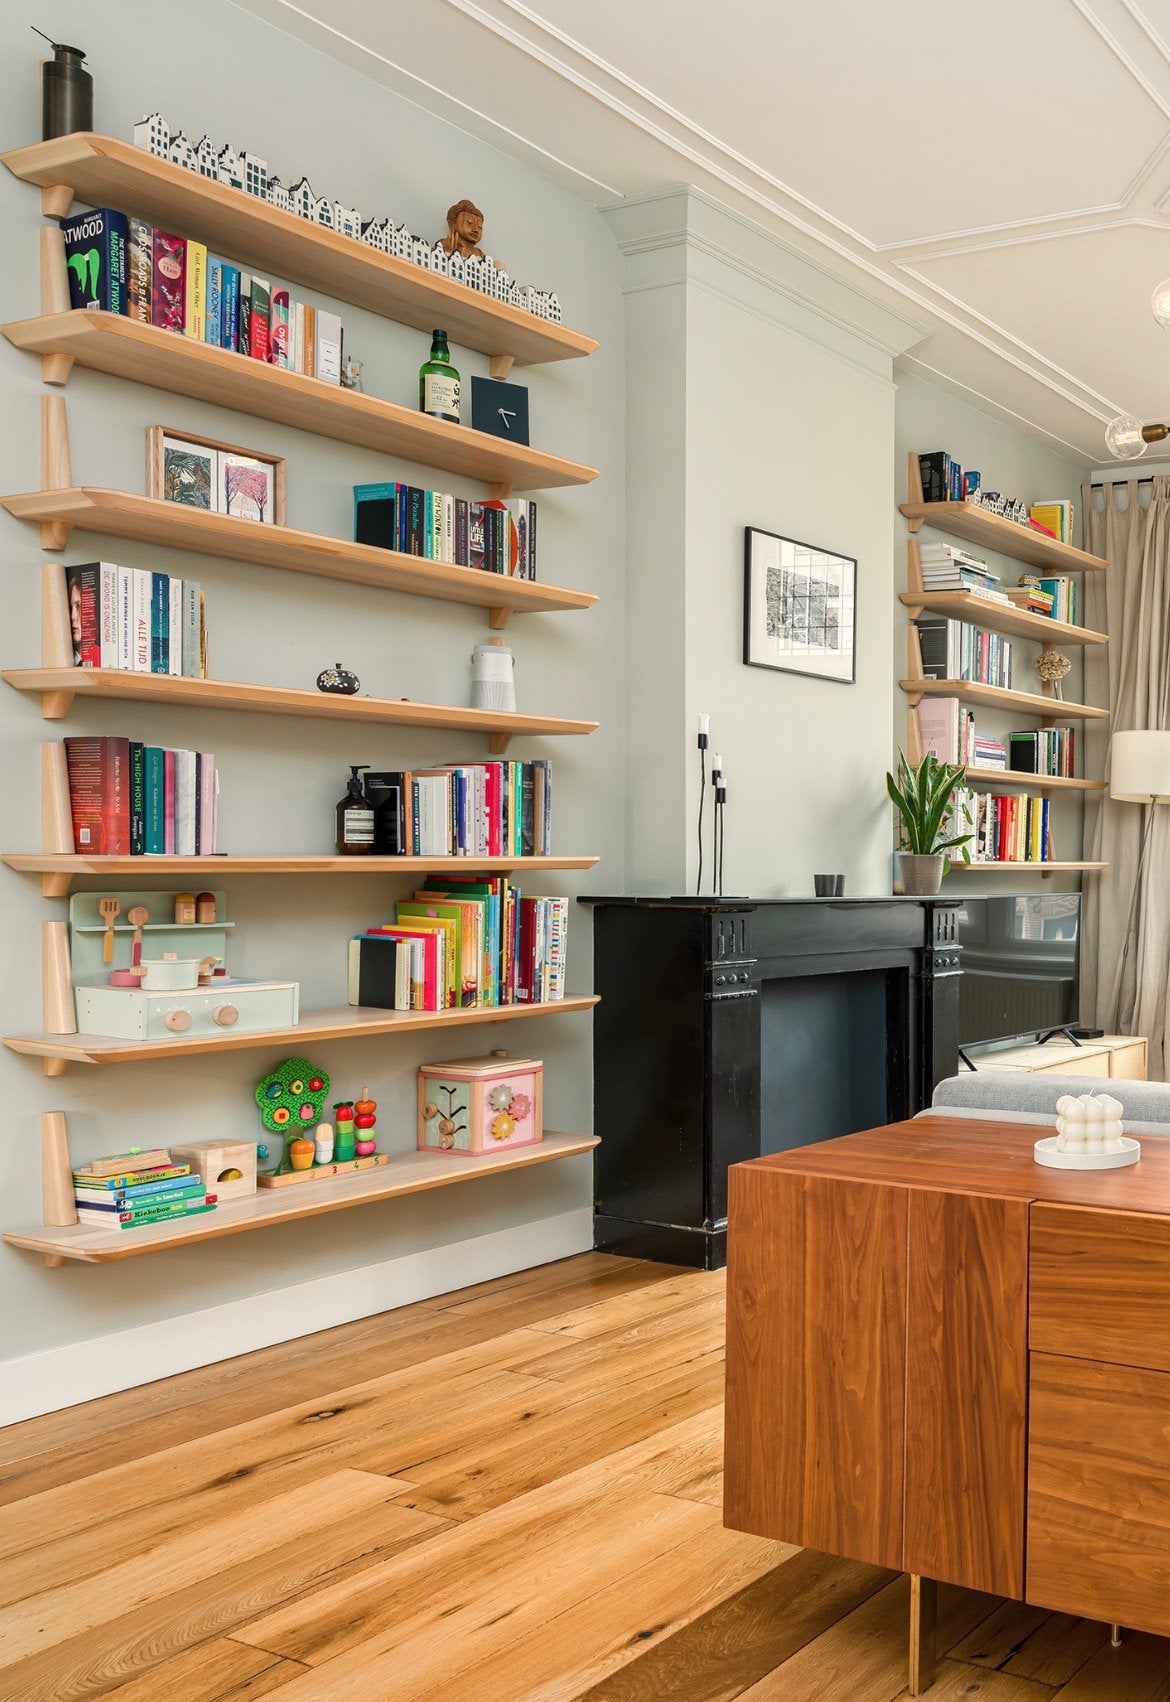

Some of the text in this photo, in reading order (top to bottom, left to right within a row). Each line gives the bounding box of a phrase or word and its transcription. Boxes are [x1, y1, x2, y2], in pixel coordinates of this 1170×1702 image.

[110, 230, 119, 278] MARGARET
[138, 226, 147, 287] CROSSROADS
[278, 327, 286, 347] OVER
[412, 493, 419, 501] To
[470, 526, 485, 534] LITTLE
[470, 533, 485, 543] LIFE
[103, 571, 110, 579] DE
[138, 619, 147, 642] ALLE
[138, 644, 147, 665] TIJD
[134, 763, 142, 784] HIGH
[134, 785, 142, 812] HOUSE
[310, 1170, 316, 1179] 2
[332, 1165, 338, 1174] 3
[353, 1161, 359, 1169] 4
[374, 1156, 379, 1165] 5
[134, 1206, 170, 1218] Kiekeboe
